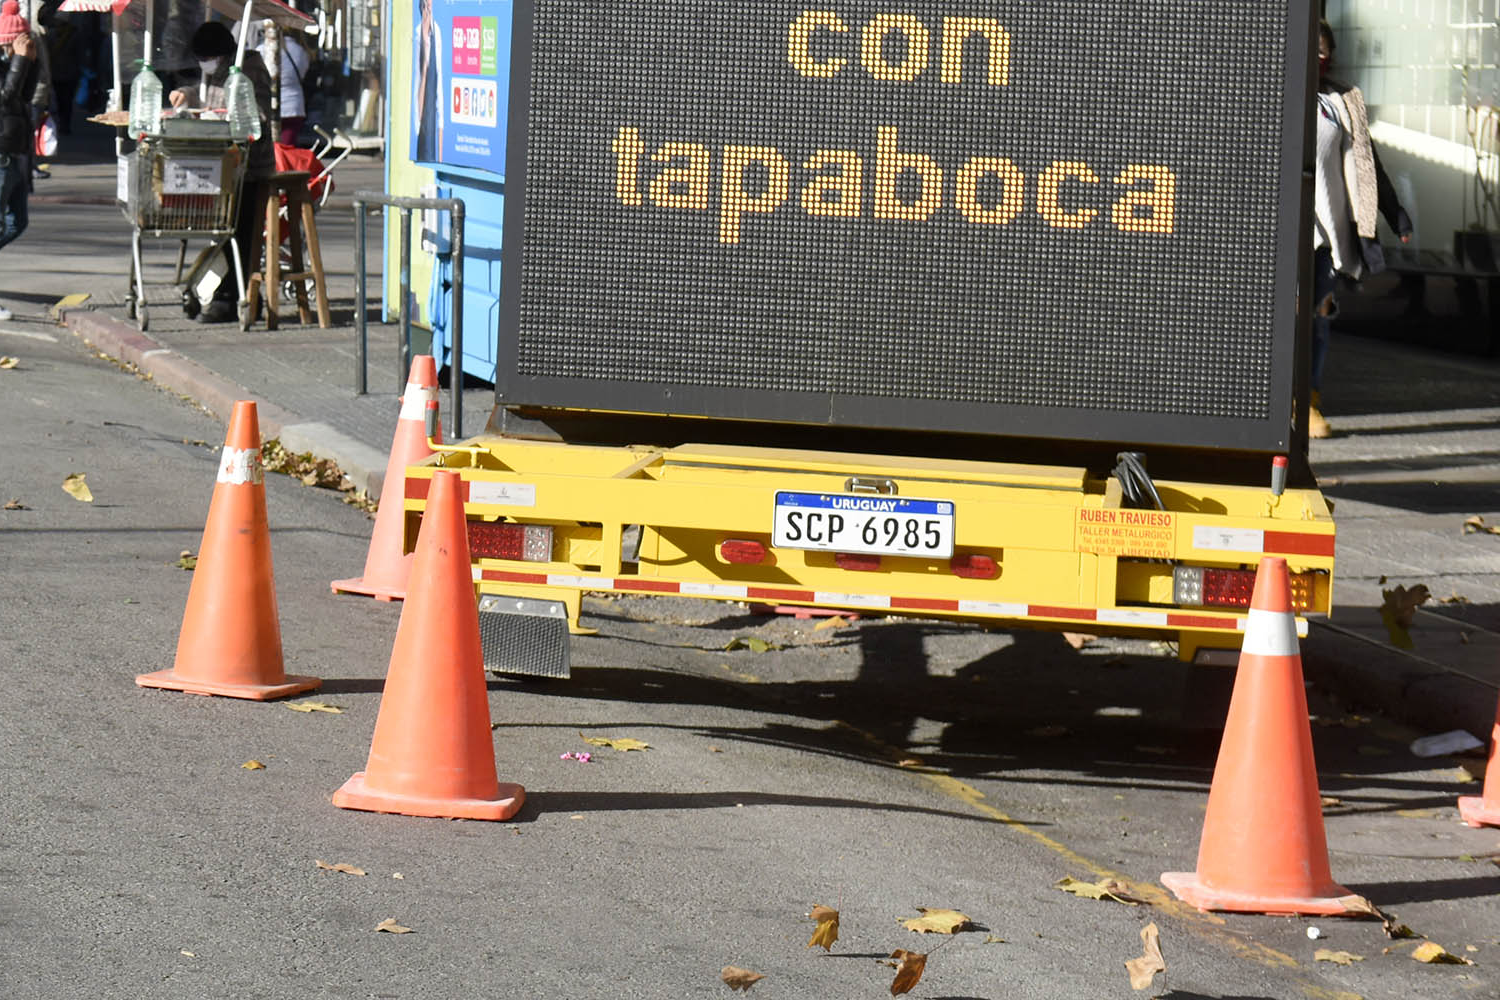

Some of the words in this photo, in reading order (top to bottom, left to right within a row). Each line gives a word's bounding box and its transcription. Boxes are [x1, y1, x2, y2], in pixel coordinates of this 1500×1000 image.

[787, 10, 1012, 86] con
[611, 126, 1176, 244] tapaboca
[832, 497, 897, 512] URUGUAY
[1080, 509, 1116, 523] RUBEN
[1119, 511, 1172, 527] TRAVIESO
[786, 511, 844, 543] SCP
[862, 516, 941, 549] 6985
[1079, 526, 1110, 537] TALLER
